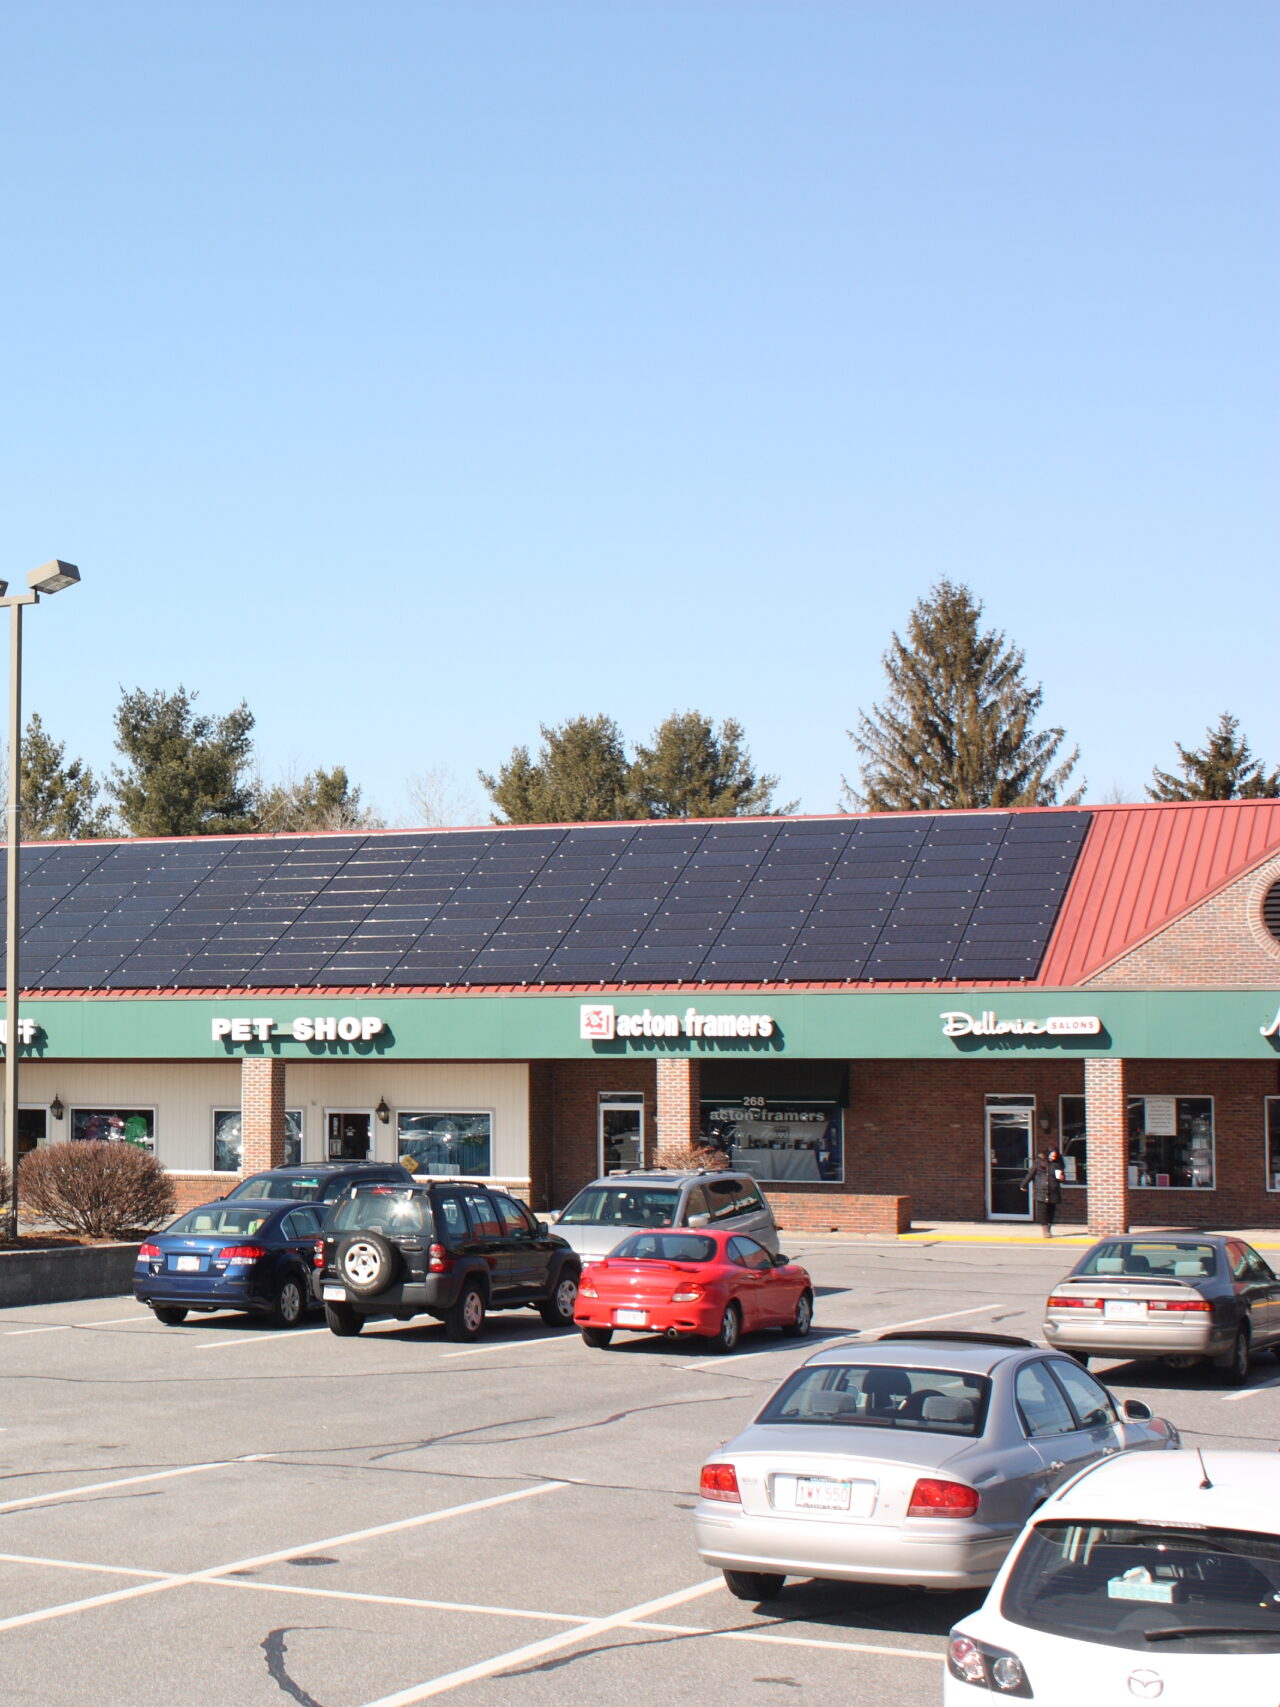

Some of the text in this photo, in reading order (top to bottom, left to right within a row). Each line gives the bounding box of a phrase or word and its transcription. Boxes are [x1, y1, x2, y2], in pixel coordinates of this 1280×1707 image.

[616, 1007, 773, 1037] acton framers
[1051, 1021, 1094, 1029] SALONS
[211, 1016, 383, 1041] PET SHOP
[743, 1096, 765, 1106] 268
[762, 1109, 825, 1121] framers
